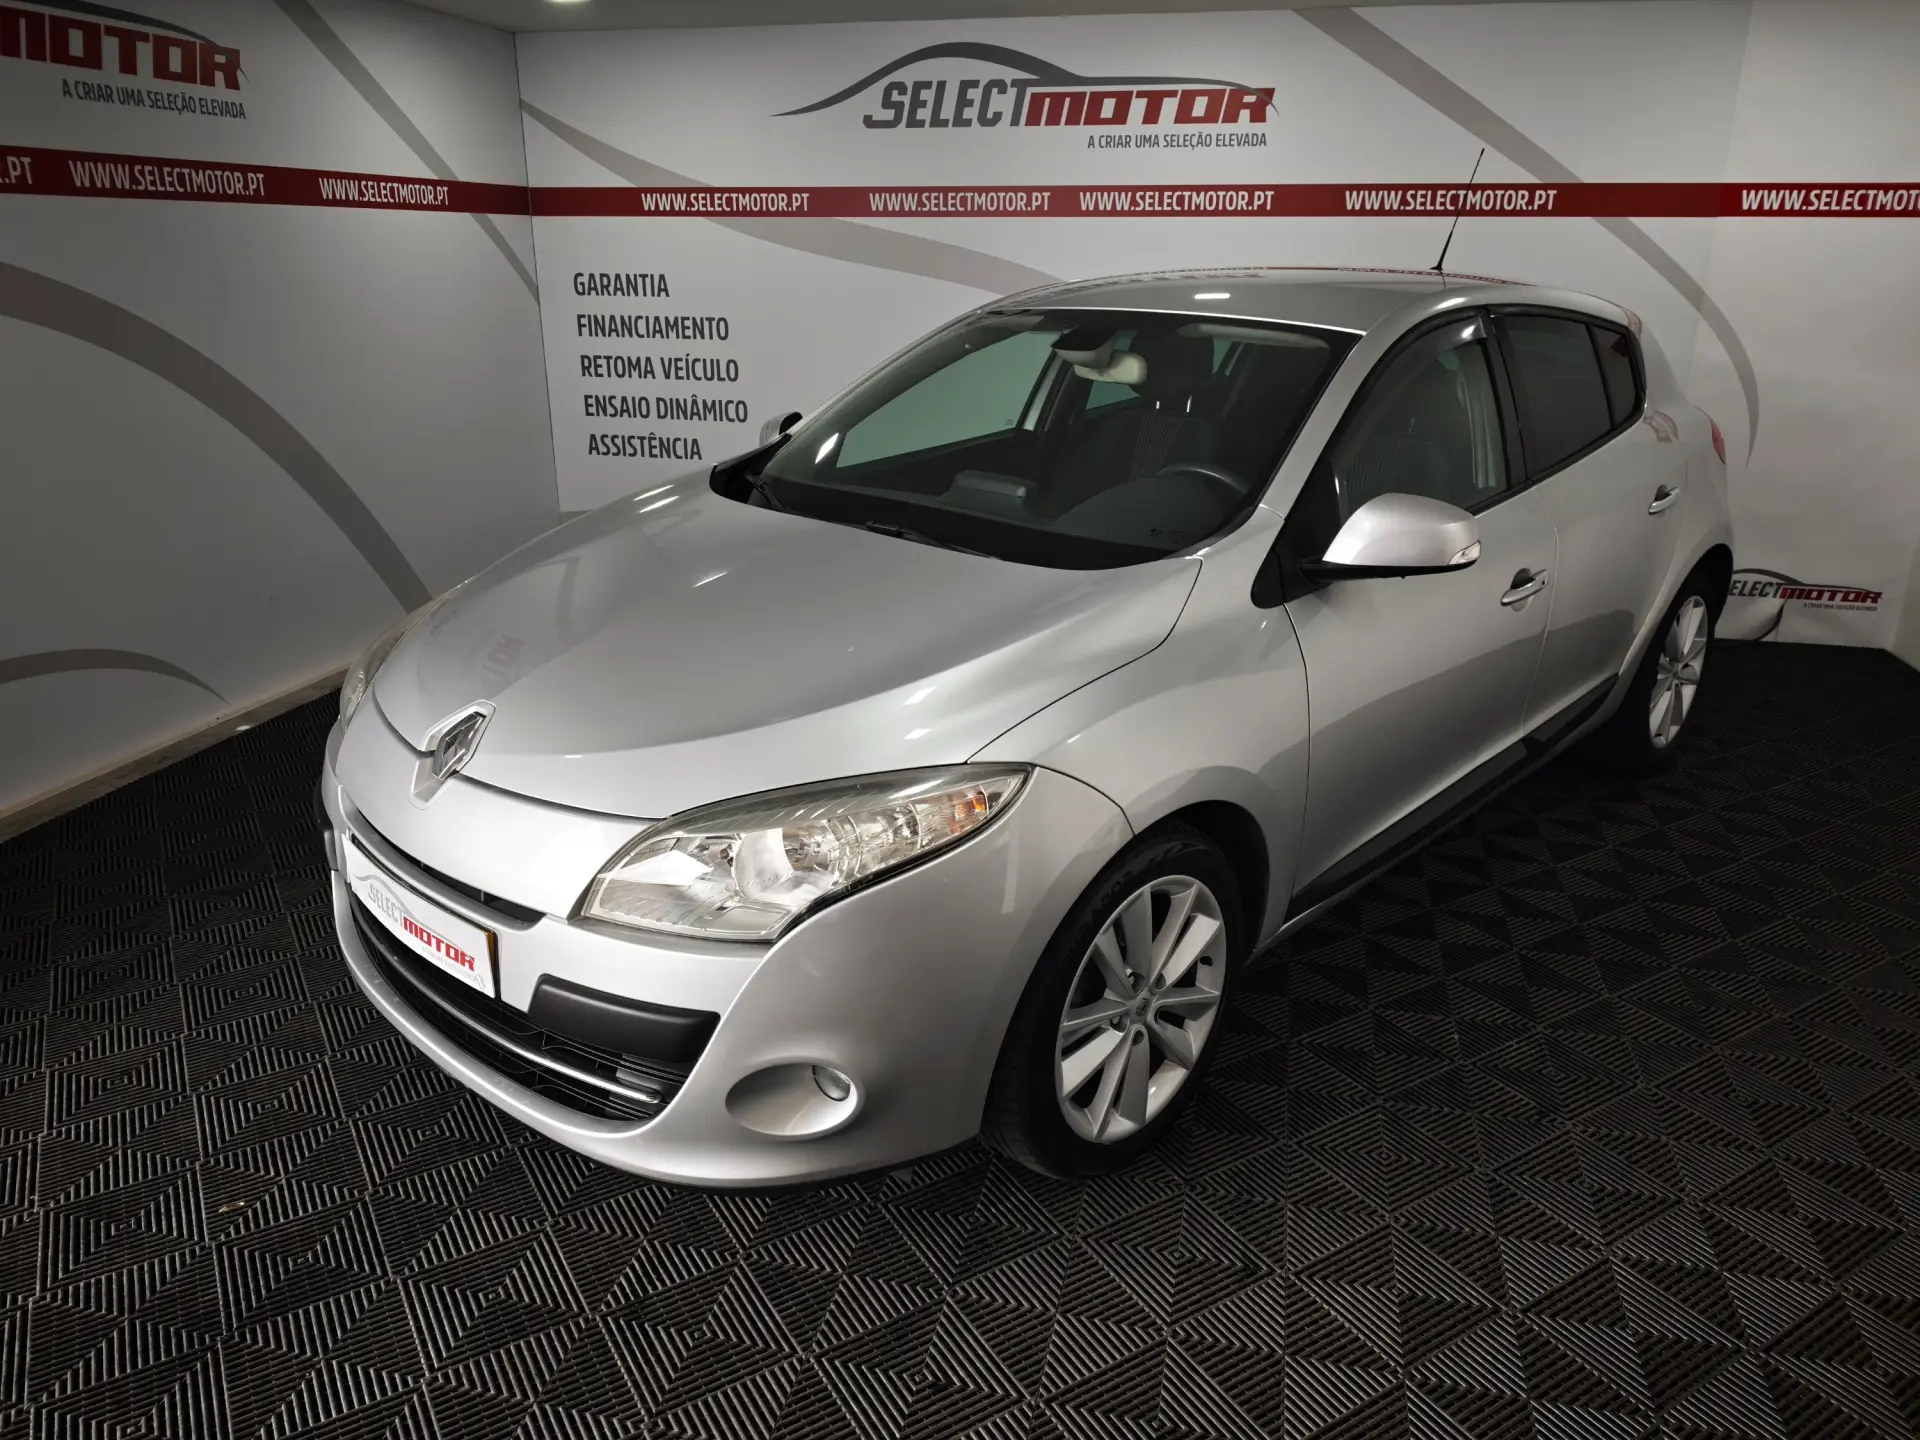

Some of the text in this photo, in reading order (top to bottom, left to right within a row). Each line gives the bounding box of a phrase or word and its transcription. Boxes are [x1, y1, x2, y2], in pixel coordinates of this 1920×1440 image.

[62, 79, 246, 120] A CRIAR UMA SELEÇÃO ELEVADA
[1087, 132, 1267, 150] A CRIAR UMA SELEÇÃO ELEVADA
[0, 156, 33, 185] .PT
[68, 160, 265, 196] WWW.SELECTMOTOR.PT
[319, 178, 448, 205] WWW.SELECTMOTOR.PT
[641, 193, 810, 211] WWW.SELECTMOTOR.PT
[869, 192, 1051, 211] WWW.SELECTMOTOR.PT
[1080, 191, 1275, 211] WWW.SELECTMOTOR.PT
[1345, 190, 1557, 211] WWW.SELECTMOTOR.PT
[1741, 189, 1920, 211] WWW.SELECTMOT
[573, 272, 670, 298] GARANTIA
[576, 314, 729, 341] FINANCIAMENTO
[580, 354, 739, 382] RETOMA VEÍCULO
[584, 394, 748, 423] ENSAIO DINÂMICO
[588, 432, 702, 460] ASSISTÊNCIA
[1730, 580, 1882, 603] ELECTMOTOR
